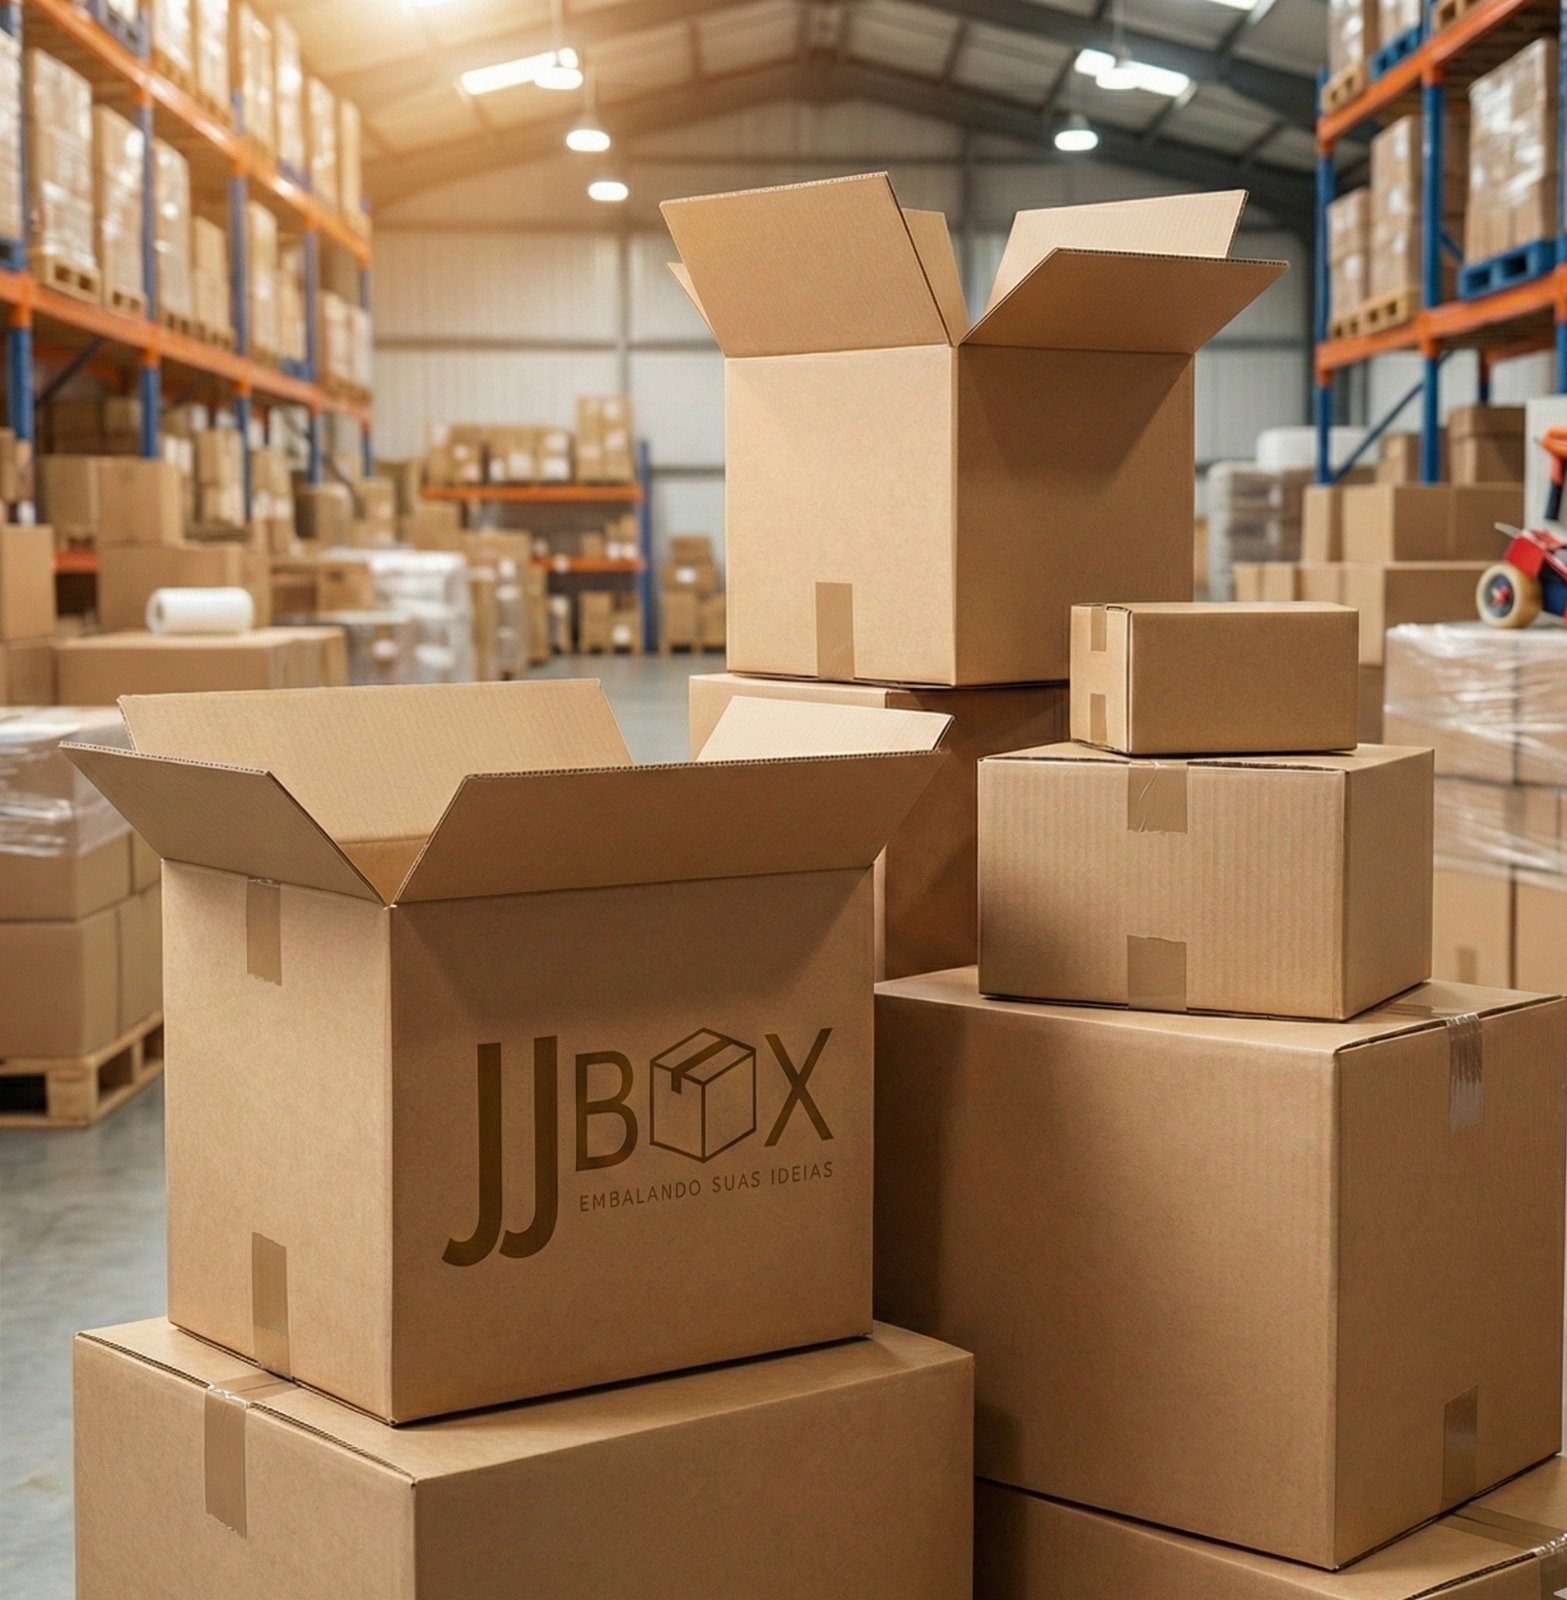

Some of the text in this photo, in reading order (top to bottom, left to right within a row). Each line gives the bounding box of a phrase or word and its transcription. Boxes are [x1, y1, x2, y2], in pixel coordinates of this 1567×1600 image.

[579, 1161, 834, 1213] EMBALANDO SUAS IDEIAS
